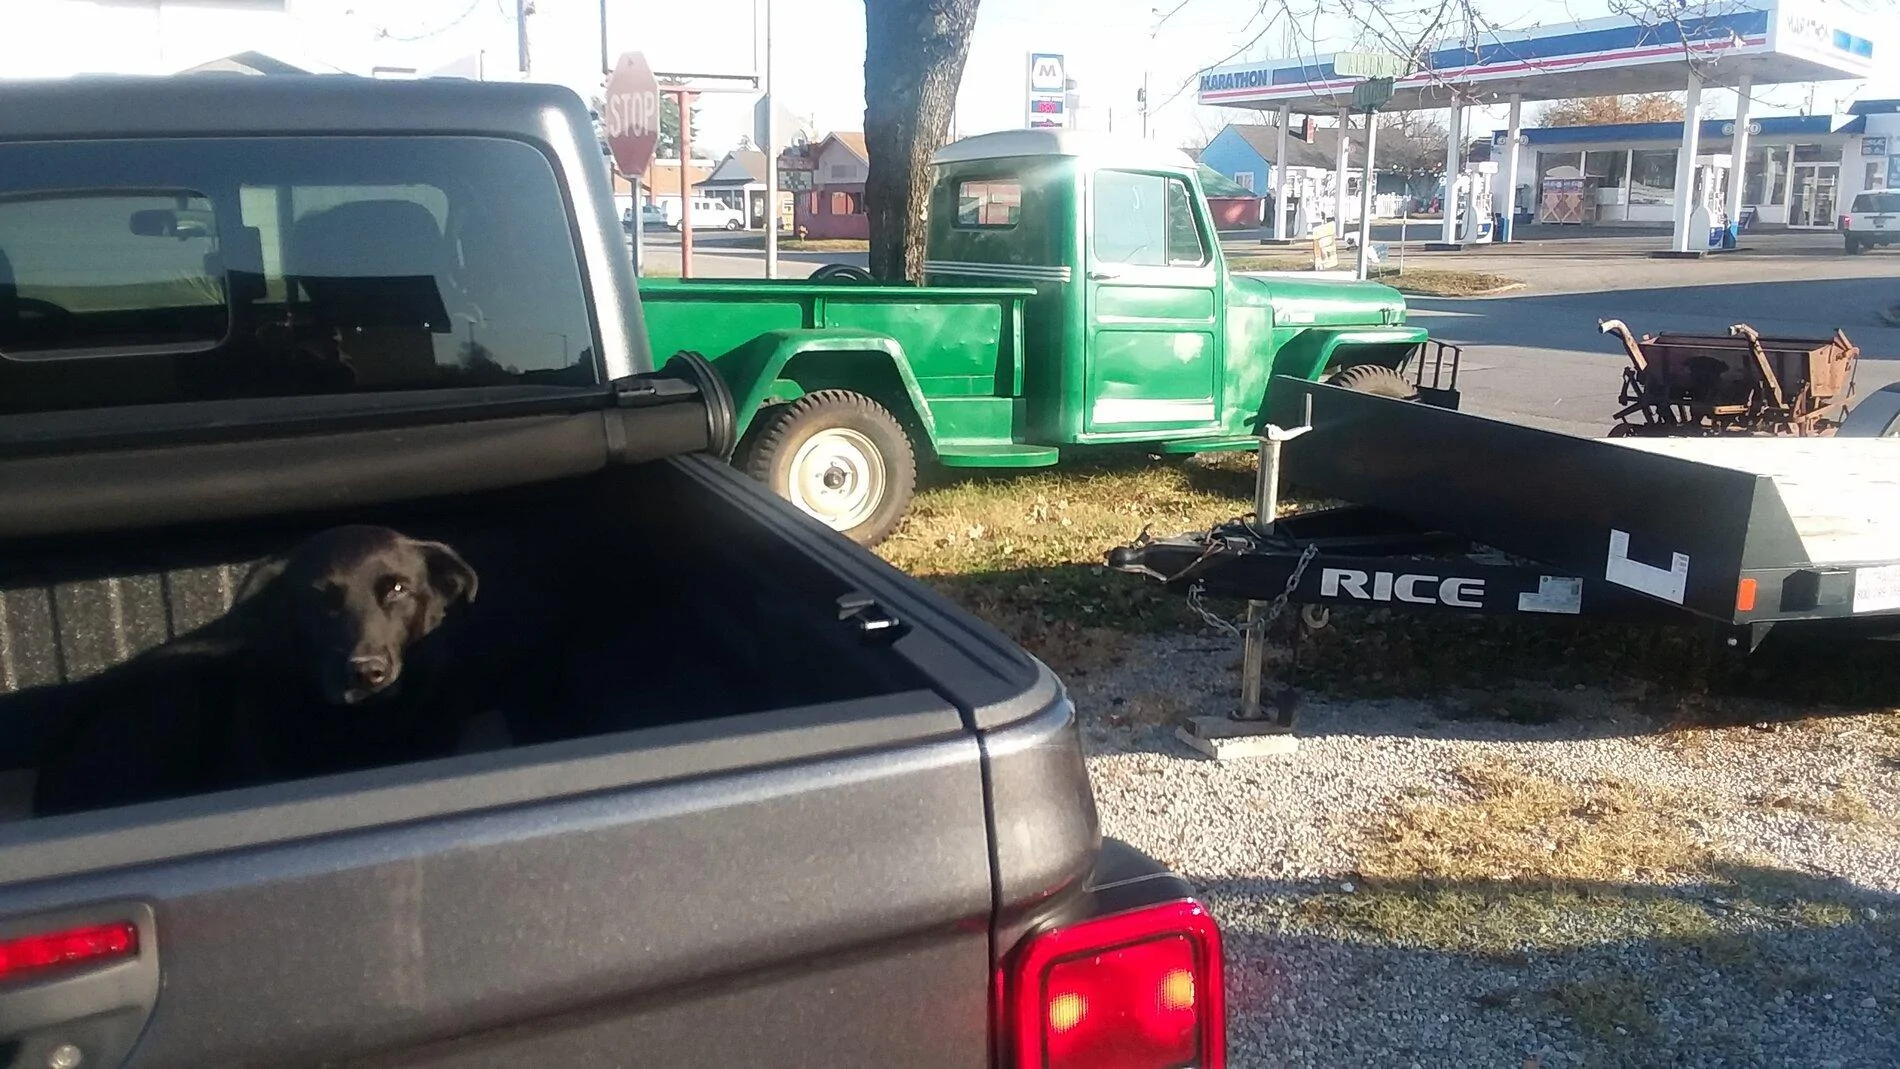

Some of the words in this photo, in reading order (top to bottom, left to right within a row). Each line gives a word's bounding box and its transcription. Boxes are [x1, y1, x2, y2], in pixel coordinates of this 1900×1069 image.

[1200, 69, 1268, 91] MARATHON
[609, 91, 655, 138] STOP
[1320, 567, 1486, 609] RICE
